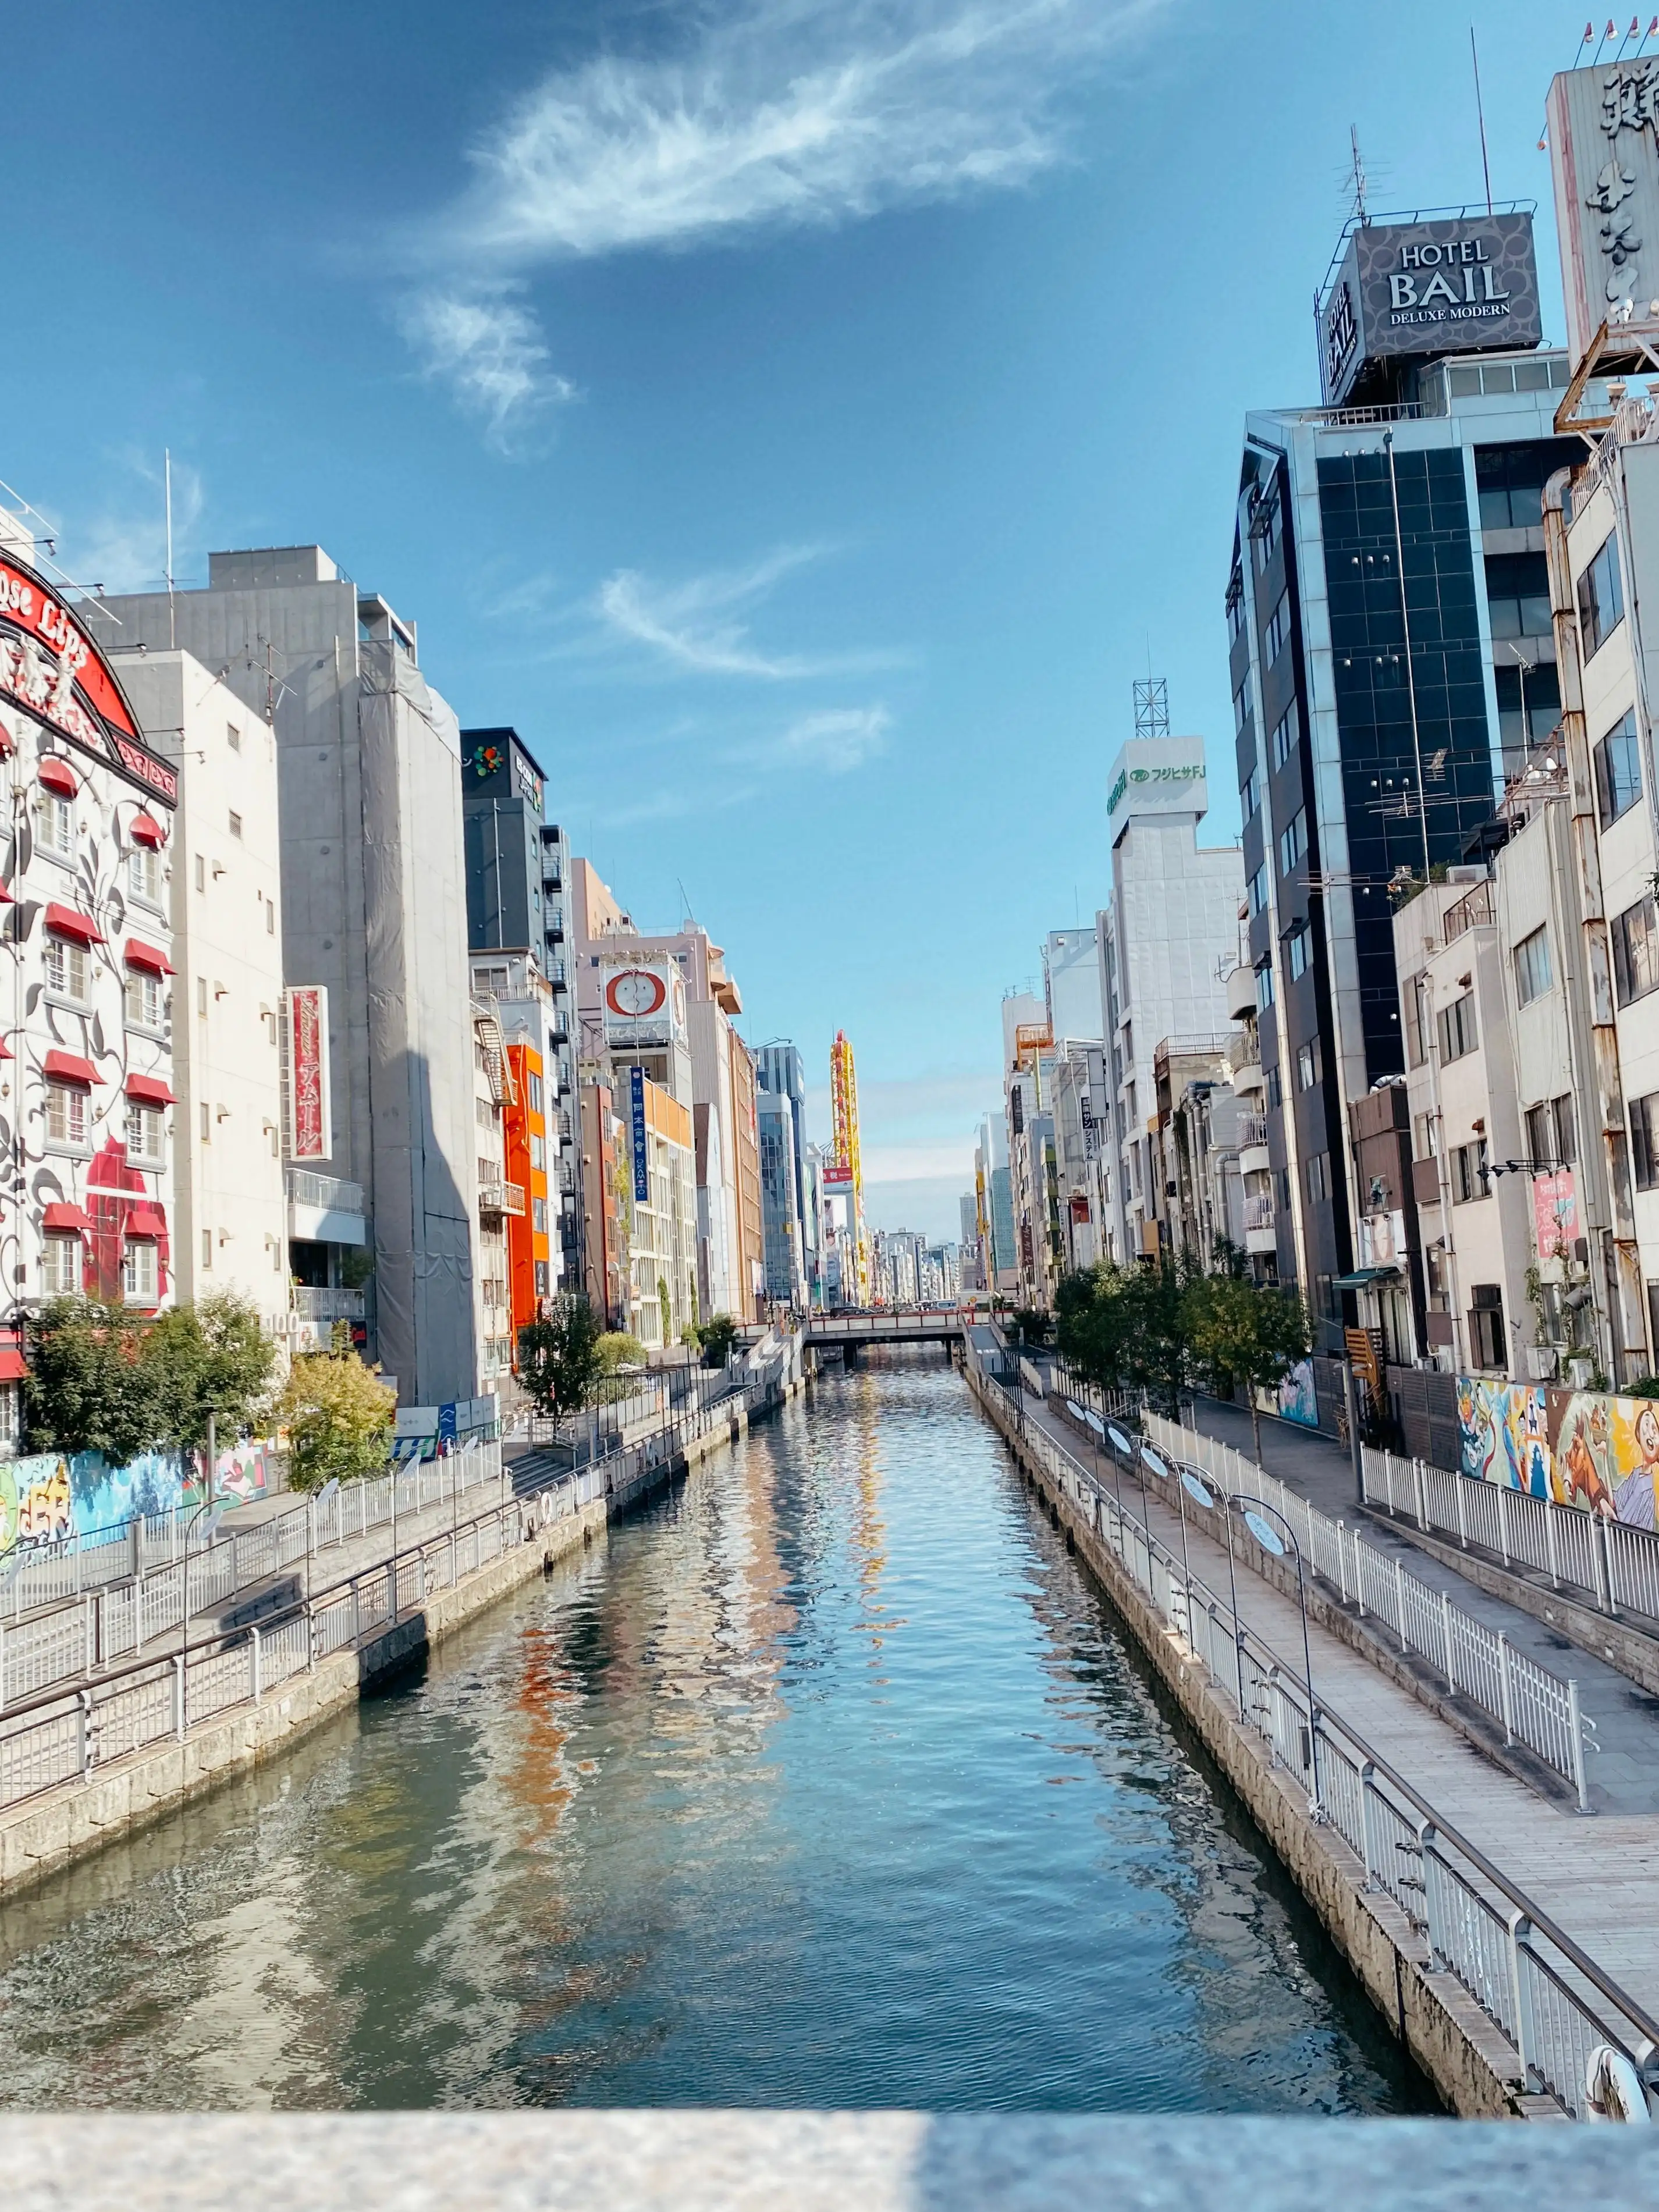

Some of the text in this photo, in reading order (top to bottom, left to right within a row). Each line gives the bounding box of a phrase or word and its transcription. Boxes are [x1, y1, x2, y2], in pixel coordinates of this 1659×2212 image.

[1401, 240, 1490, 268] HOTEL
[1388, 265, 1511, 309] BAIL
[1390, 303, 1511, 325] DELUXE MODERN
[1327, 302, 1353, 386] BAIL
[37, 599, 87, 668] Lips
[298, 1063, 319, 1148] アムール
